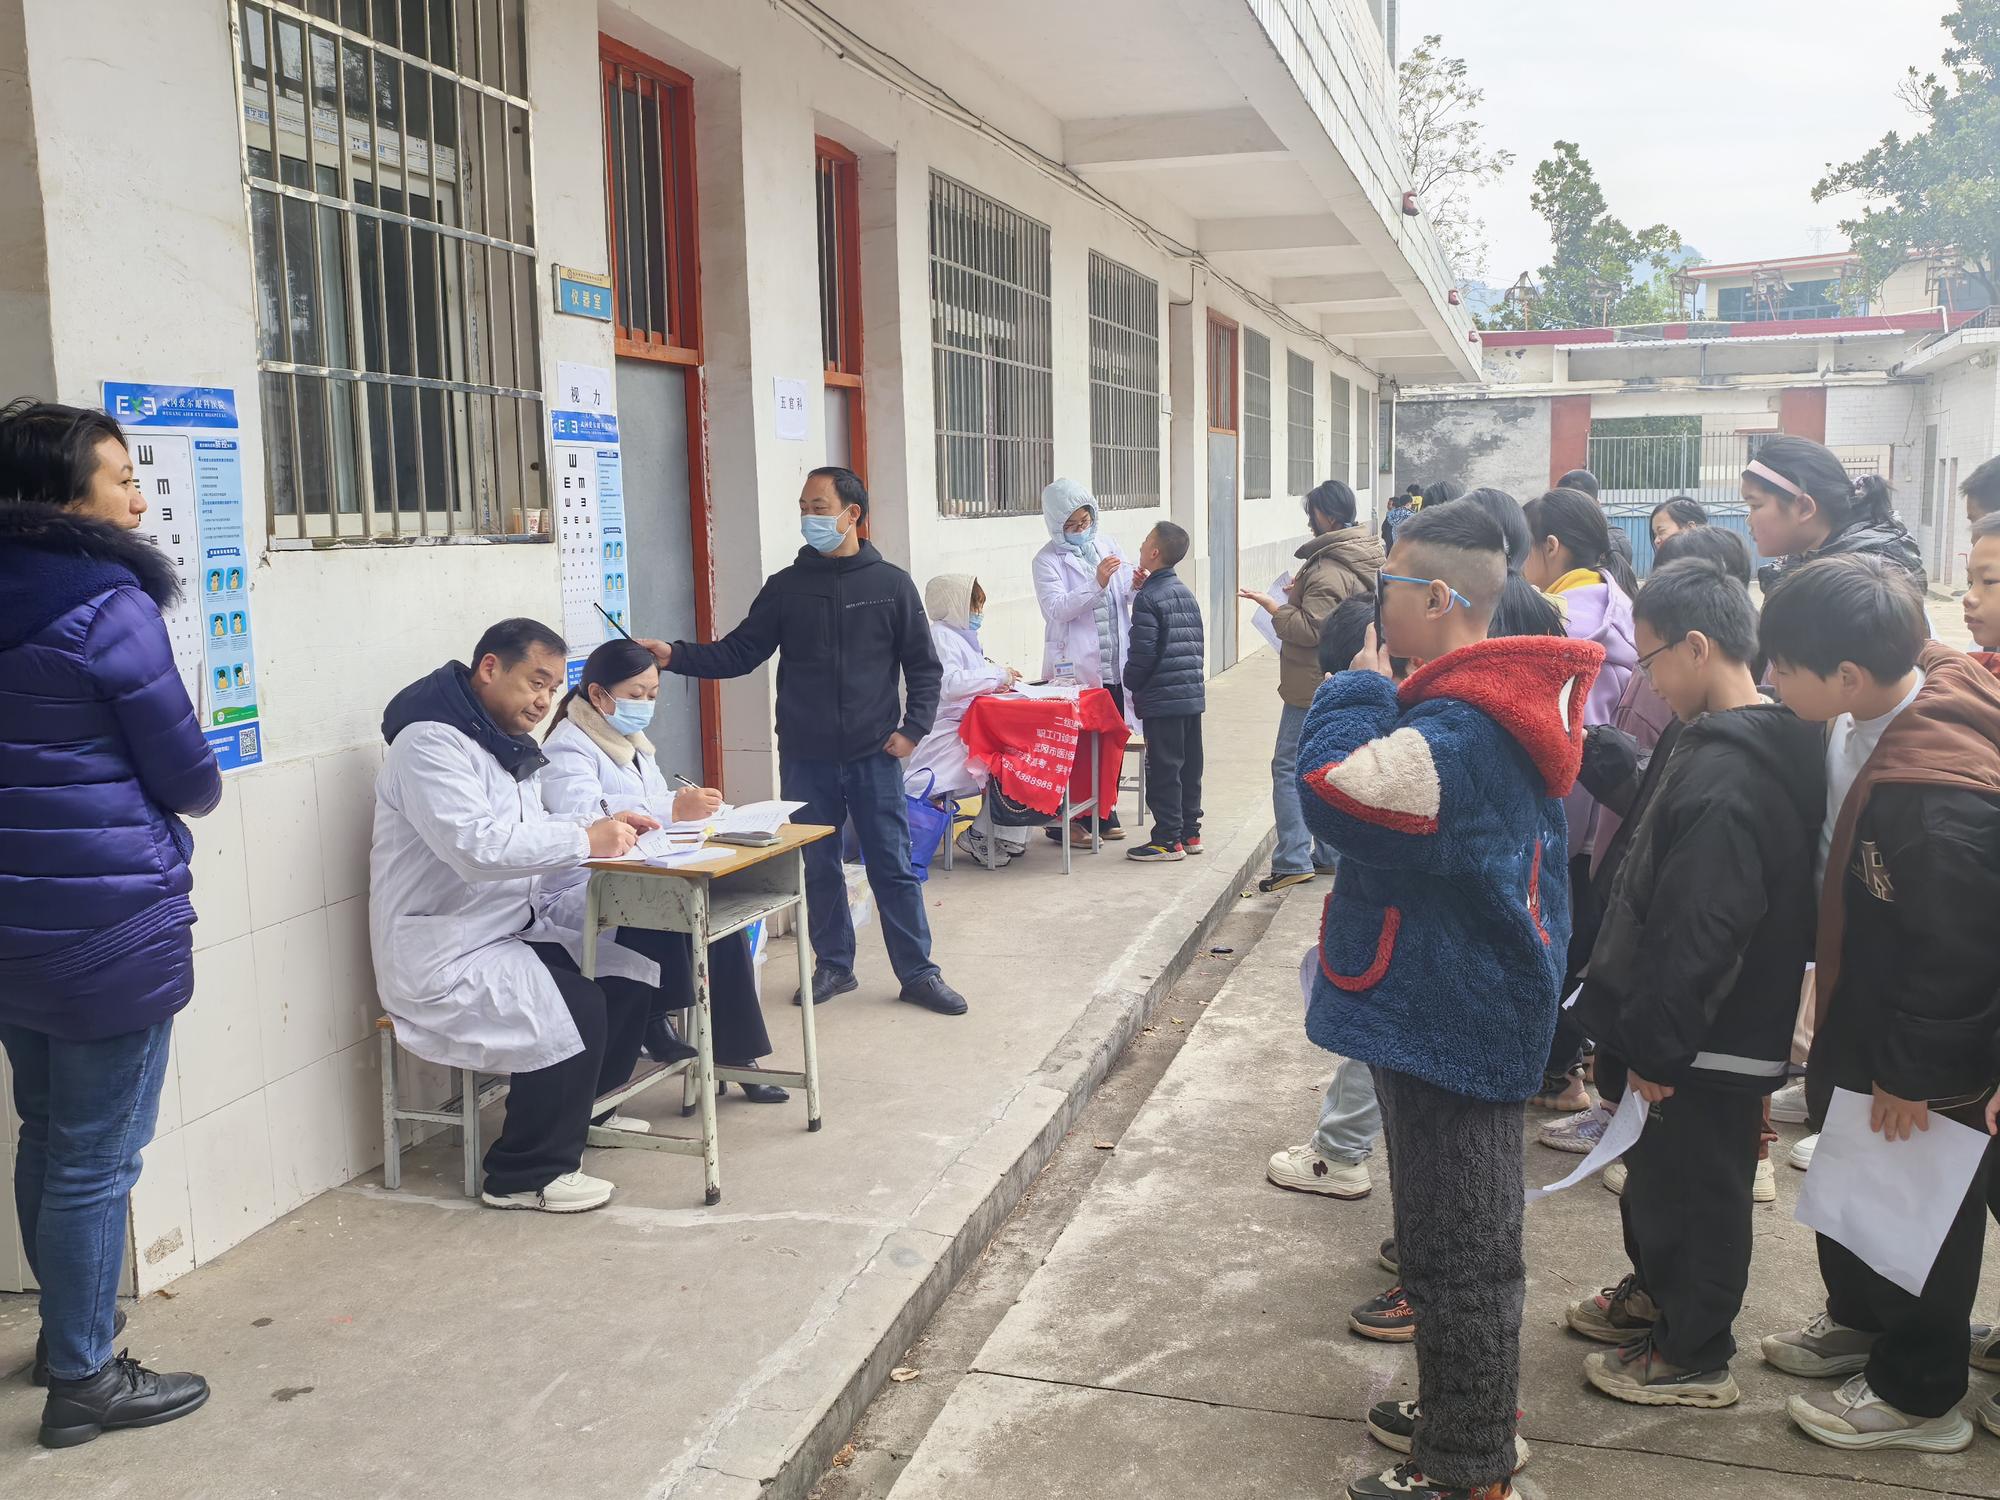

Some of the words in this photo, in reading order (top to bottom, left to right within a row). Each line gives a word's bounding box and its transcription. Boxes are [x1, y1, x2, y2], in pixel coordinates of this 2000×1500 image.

[162, 397, 226, 410] 武冈爱尔眼科医院
[571, 385, 601, 406] 视力
[780, 395, 803, 412] 五官科
